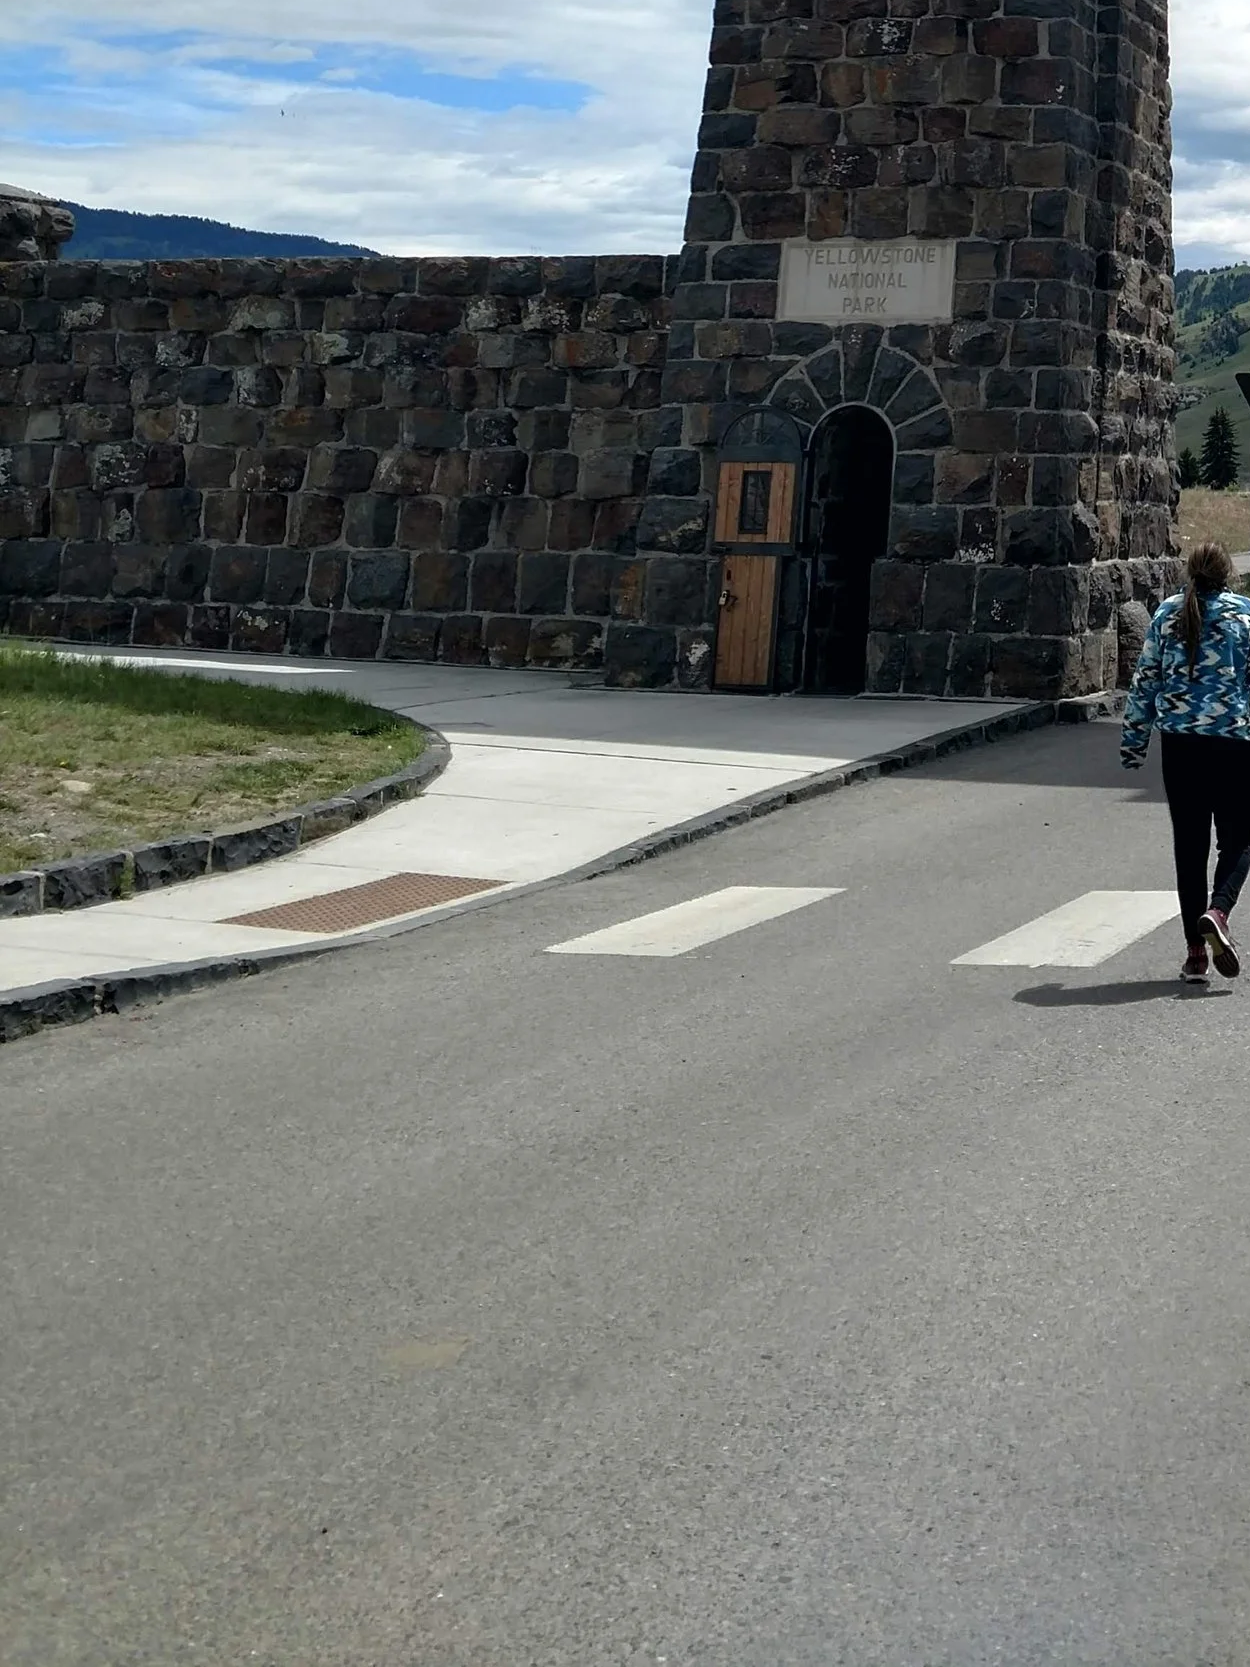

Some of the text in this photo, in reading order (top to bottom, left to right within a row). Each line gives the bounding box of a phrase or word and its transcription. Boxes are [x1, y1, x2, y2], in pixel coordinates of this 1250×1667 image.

[804, 247, 937, 265] YELLOWSTONE
[827, 272, 908, 290] NATIONAL
[842, 296, 888, 314] PARK
